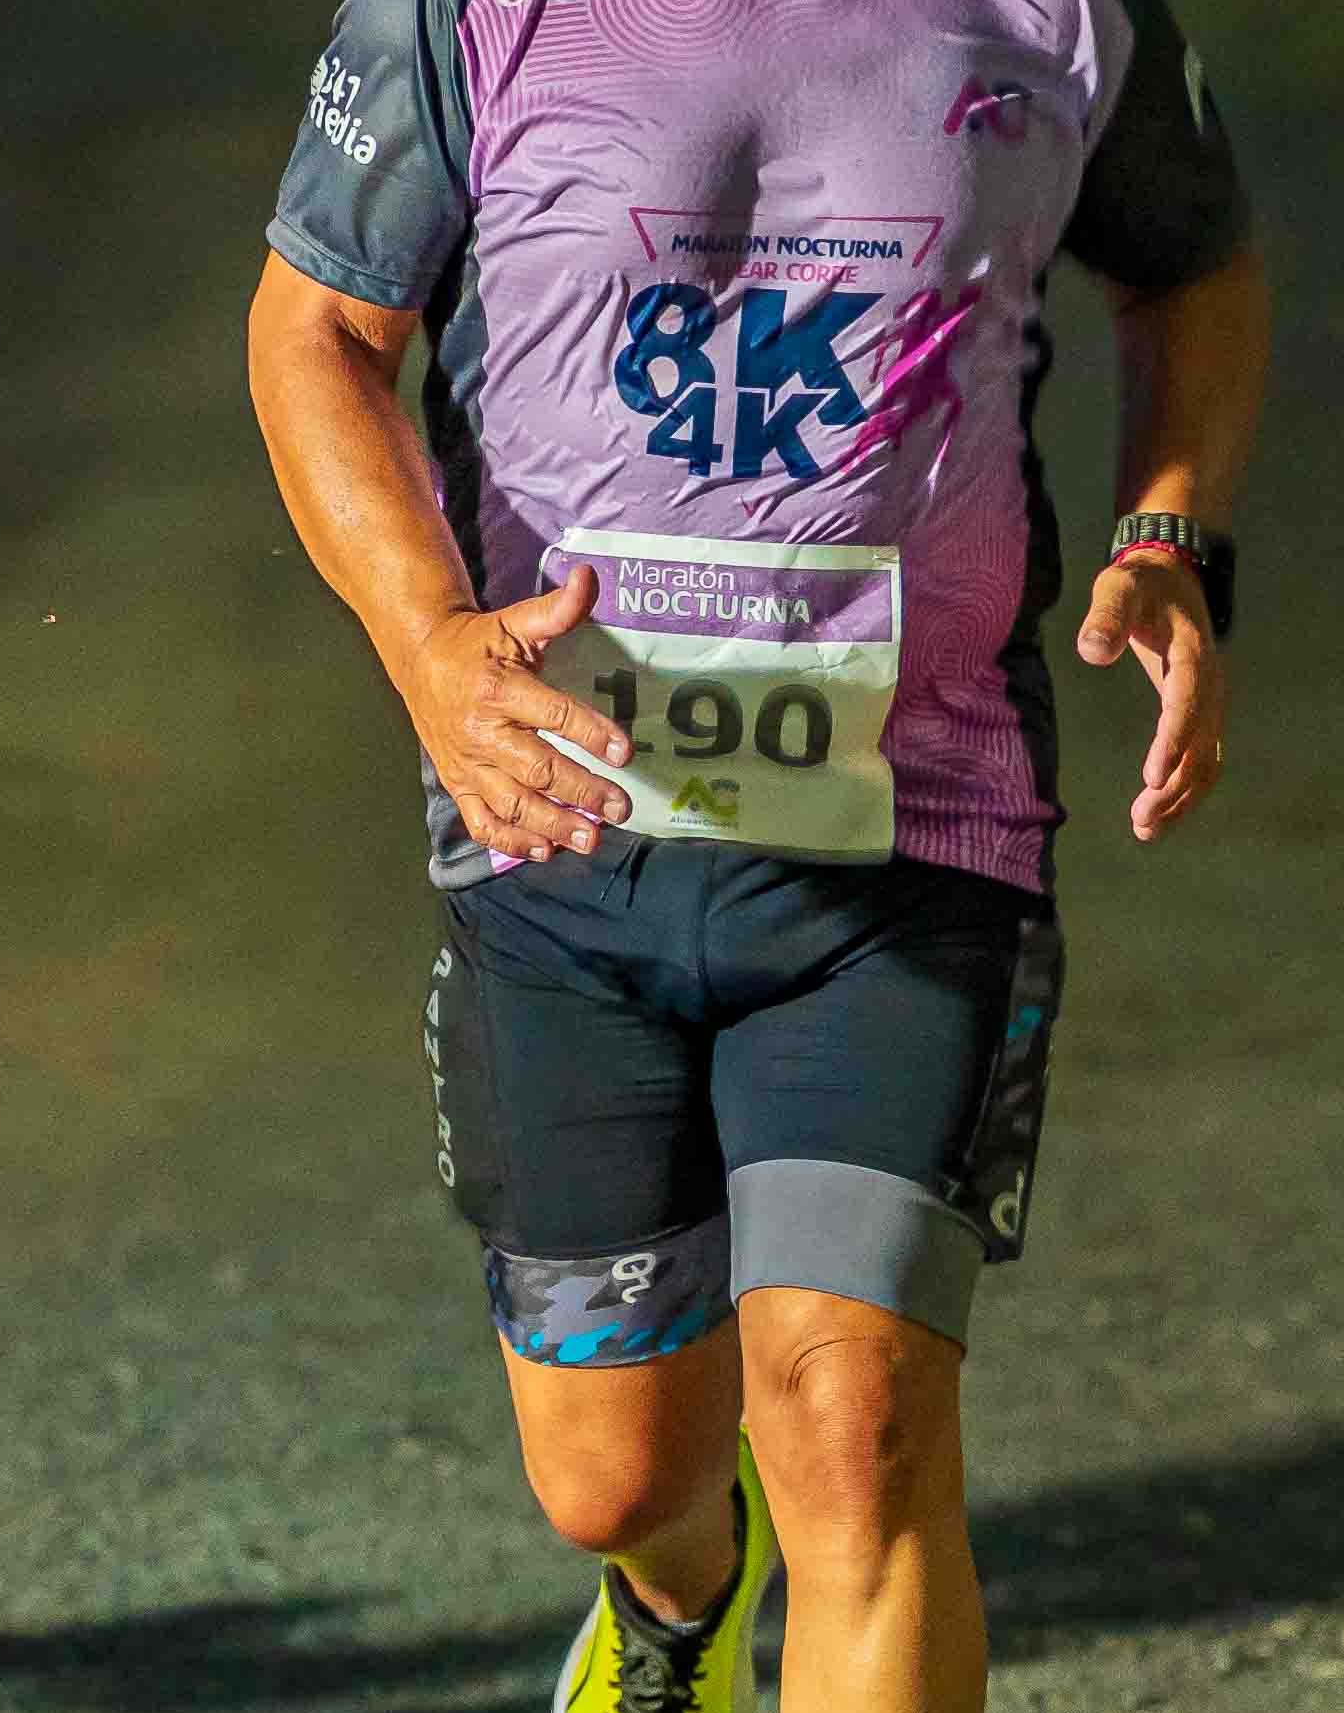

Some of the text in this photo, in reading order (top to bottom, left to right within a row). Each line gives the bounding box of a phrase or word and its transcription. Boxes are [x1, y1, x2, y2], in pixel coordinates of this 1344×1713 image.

[776, 236, 904, 259] NOCTURNA
[785, 260, 861, 284] CORRE
[614, 282, 888, 429] 8K
[646, 386, 830, 480] 4K
[618, 558, 735, 591] Maratón
[617, 586, 811, 624] NOCTURNA
[593, 668, 834, 768] 190
